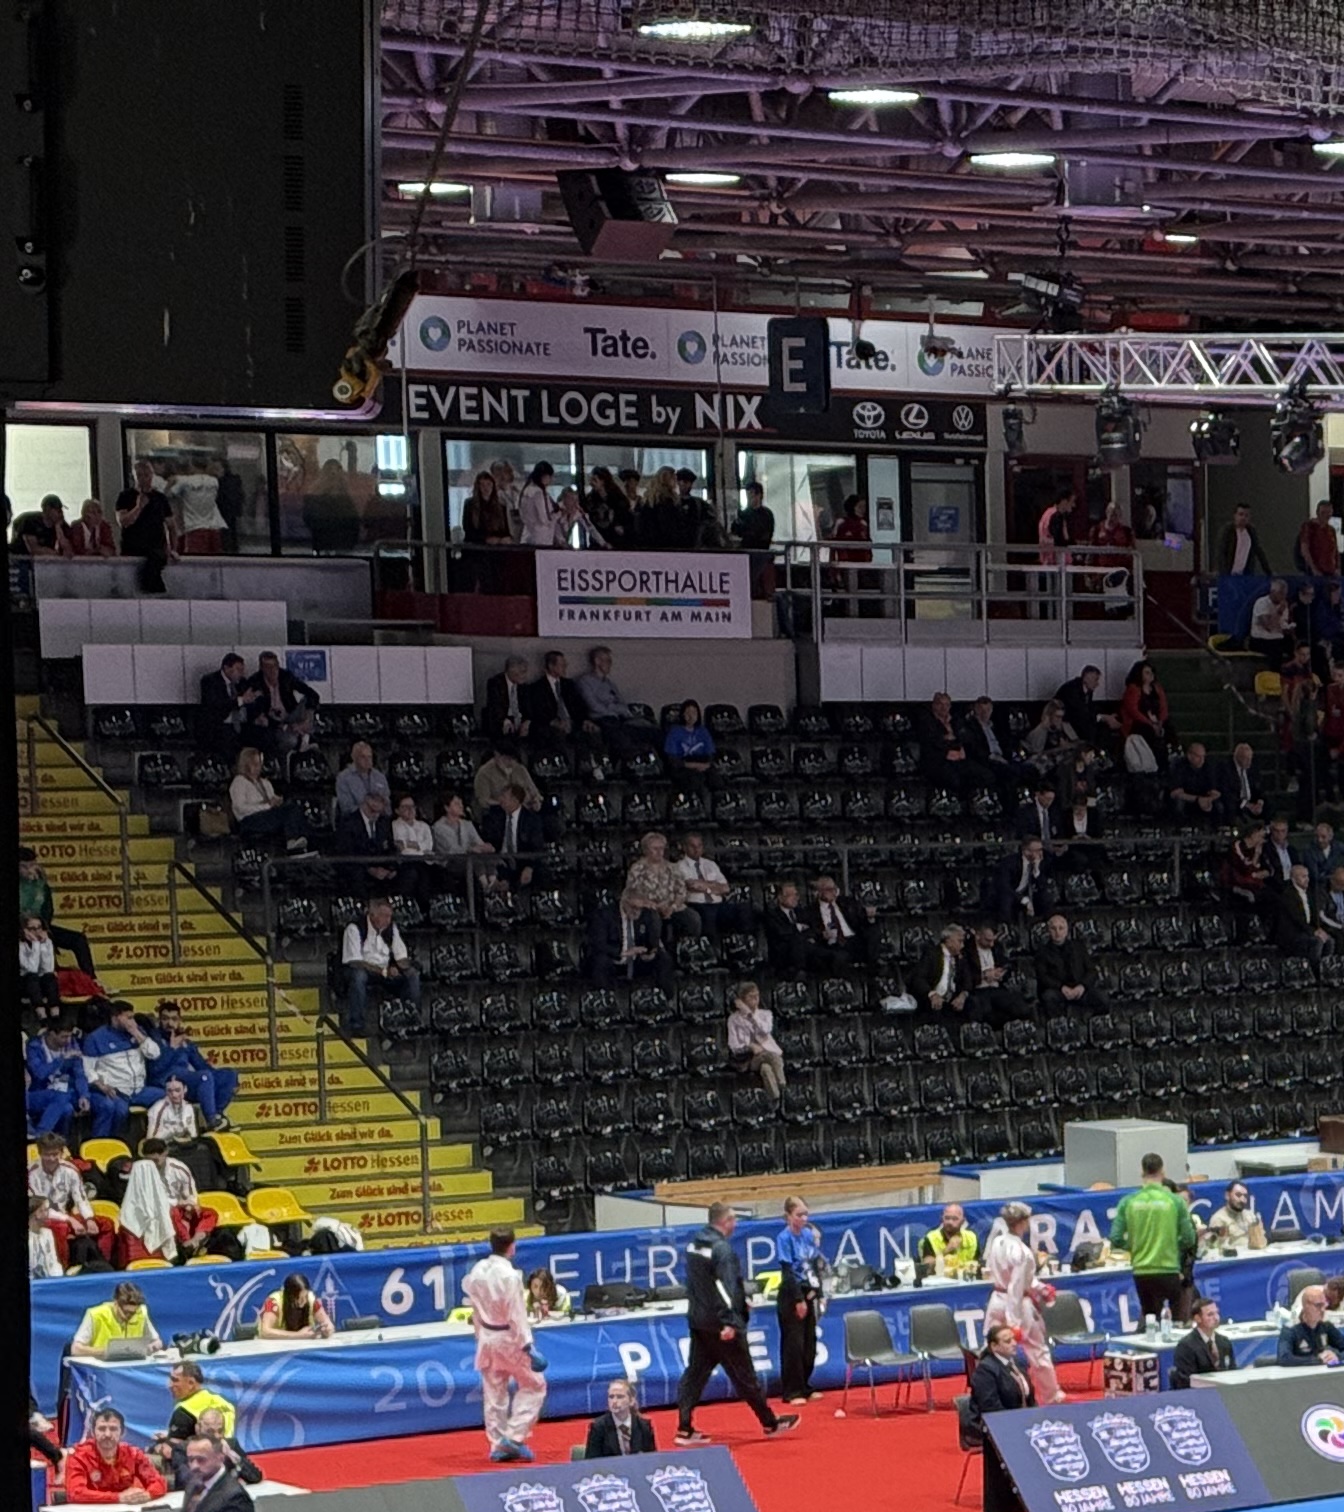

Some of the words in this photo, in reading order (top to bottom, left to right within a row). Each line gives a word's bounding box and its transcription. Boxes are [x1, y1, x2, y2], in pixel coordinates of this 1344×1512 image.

[457, 319, 517, 336] PLANET
[457, 337, 552, 357] PASSIONATE
[583, 327, 657, 360] Tate.
[781, 337, 807, 392] E
[408, 384, 531, 424] EVENT
[541, 389, 638, 427] LOGE
[651, 394, 681, 434] by
[694, 392, 762, 430] NIX
[853, 429, 886, 440] TOYOTA
[557, 568, 731, 594] EISSPORTHALLE
[558, 608, 652, 623] FRANKFURT
[660, 609, 684, 623] AM
[690, 611, 732, 624] MAIN
[79, 894, 122, 908] LOTTO
[125, 944, 170, 958] LOTTO
[223, 1049, 268, 1062] LOTTO
[274, 1102, 319, 1116] LOTTO
[323, 1156, 368, 1172] LOTTO
[370, 1153, 419, 1169] Hessen
[377, 1210, 422, 1227] LOTTO
[1118, 1476, 1169, 1496] HESSEN
[1179, 1469, 1231, 1489] HESSEN
[1054, 1485, 1109, 1504] HESSEN
